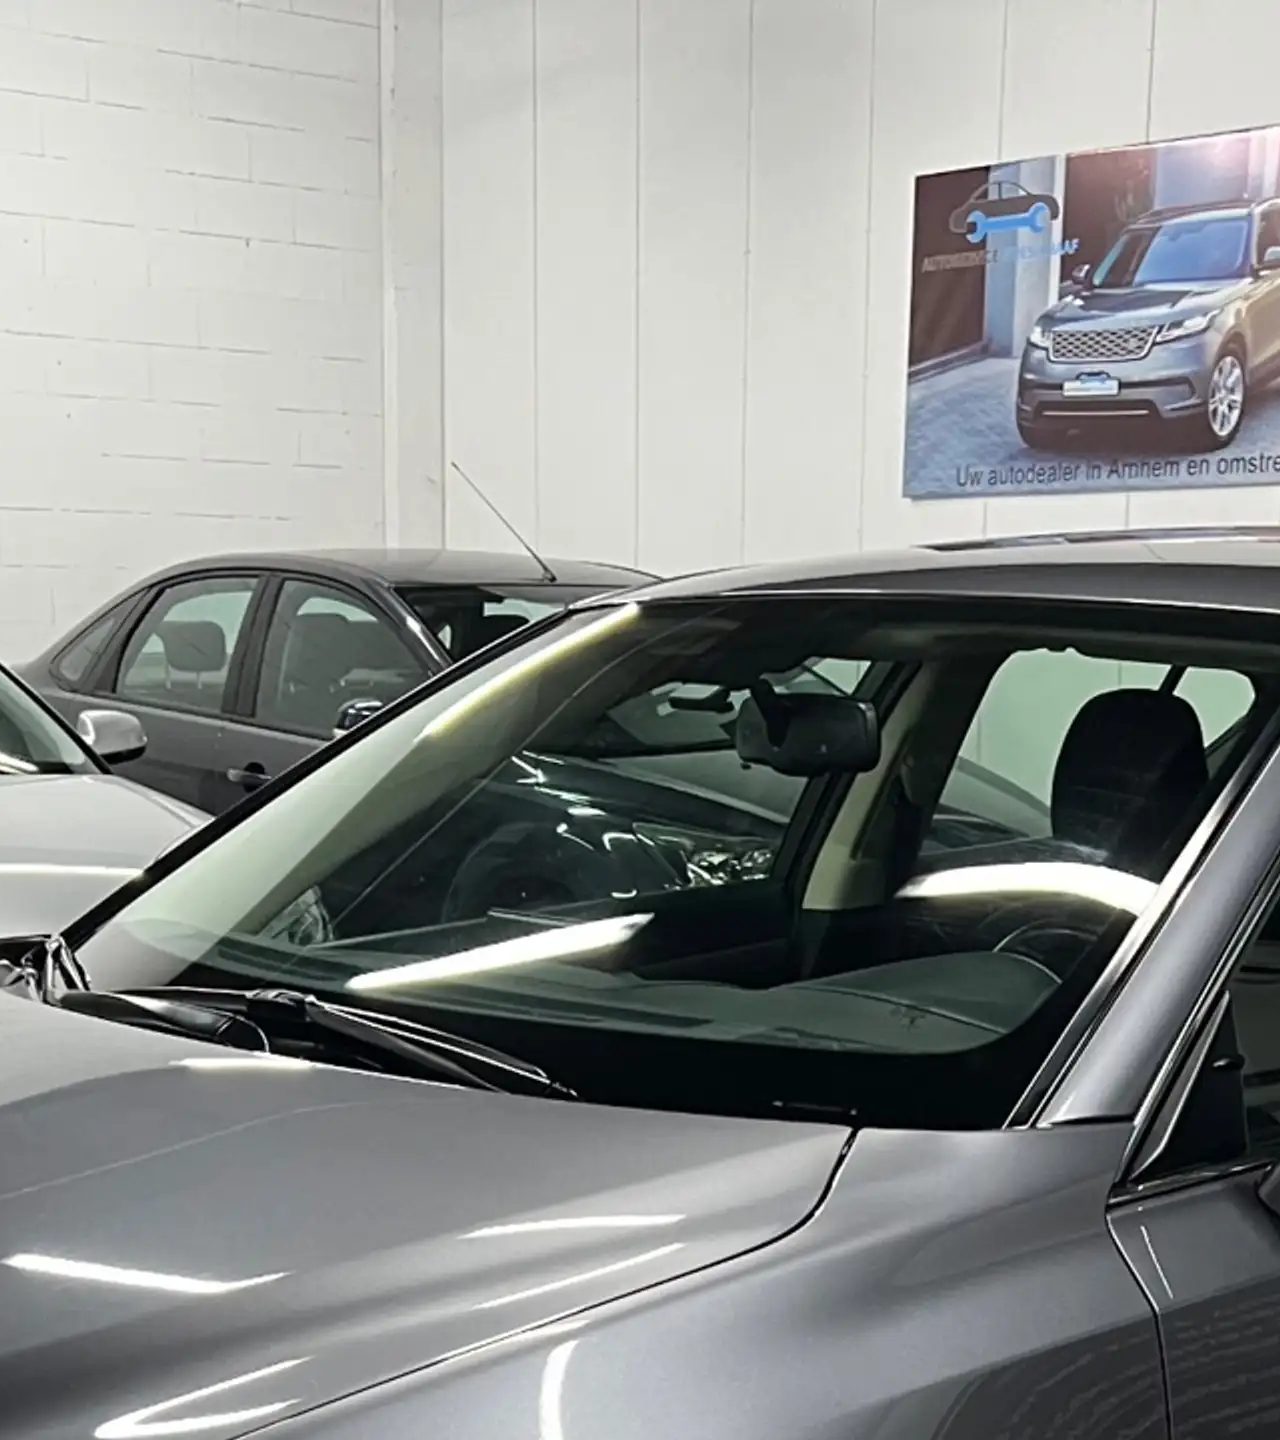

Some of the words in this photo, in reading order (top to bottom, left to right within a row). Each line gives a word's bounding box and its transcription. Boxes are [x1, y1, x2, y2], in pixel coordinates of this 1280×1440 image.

[956, 463, 983, 487] Uw
[988, 461, 1081, 486] autodealer
[1086, 458, 1100, 480] in
[1107, 456, 1179, 479] Arnhem
[1187, 458, 1210, 476] en
